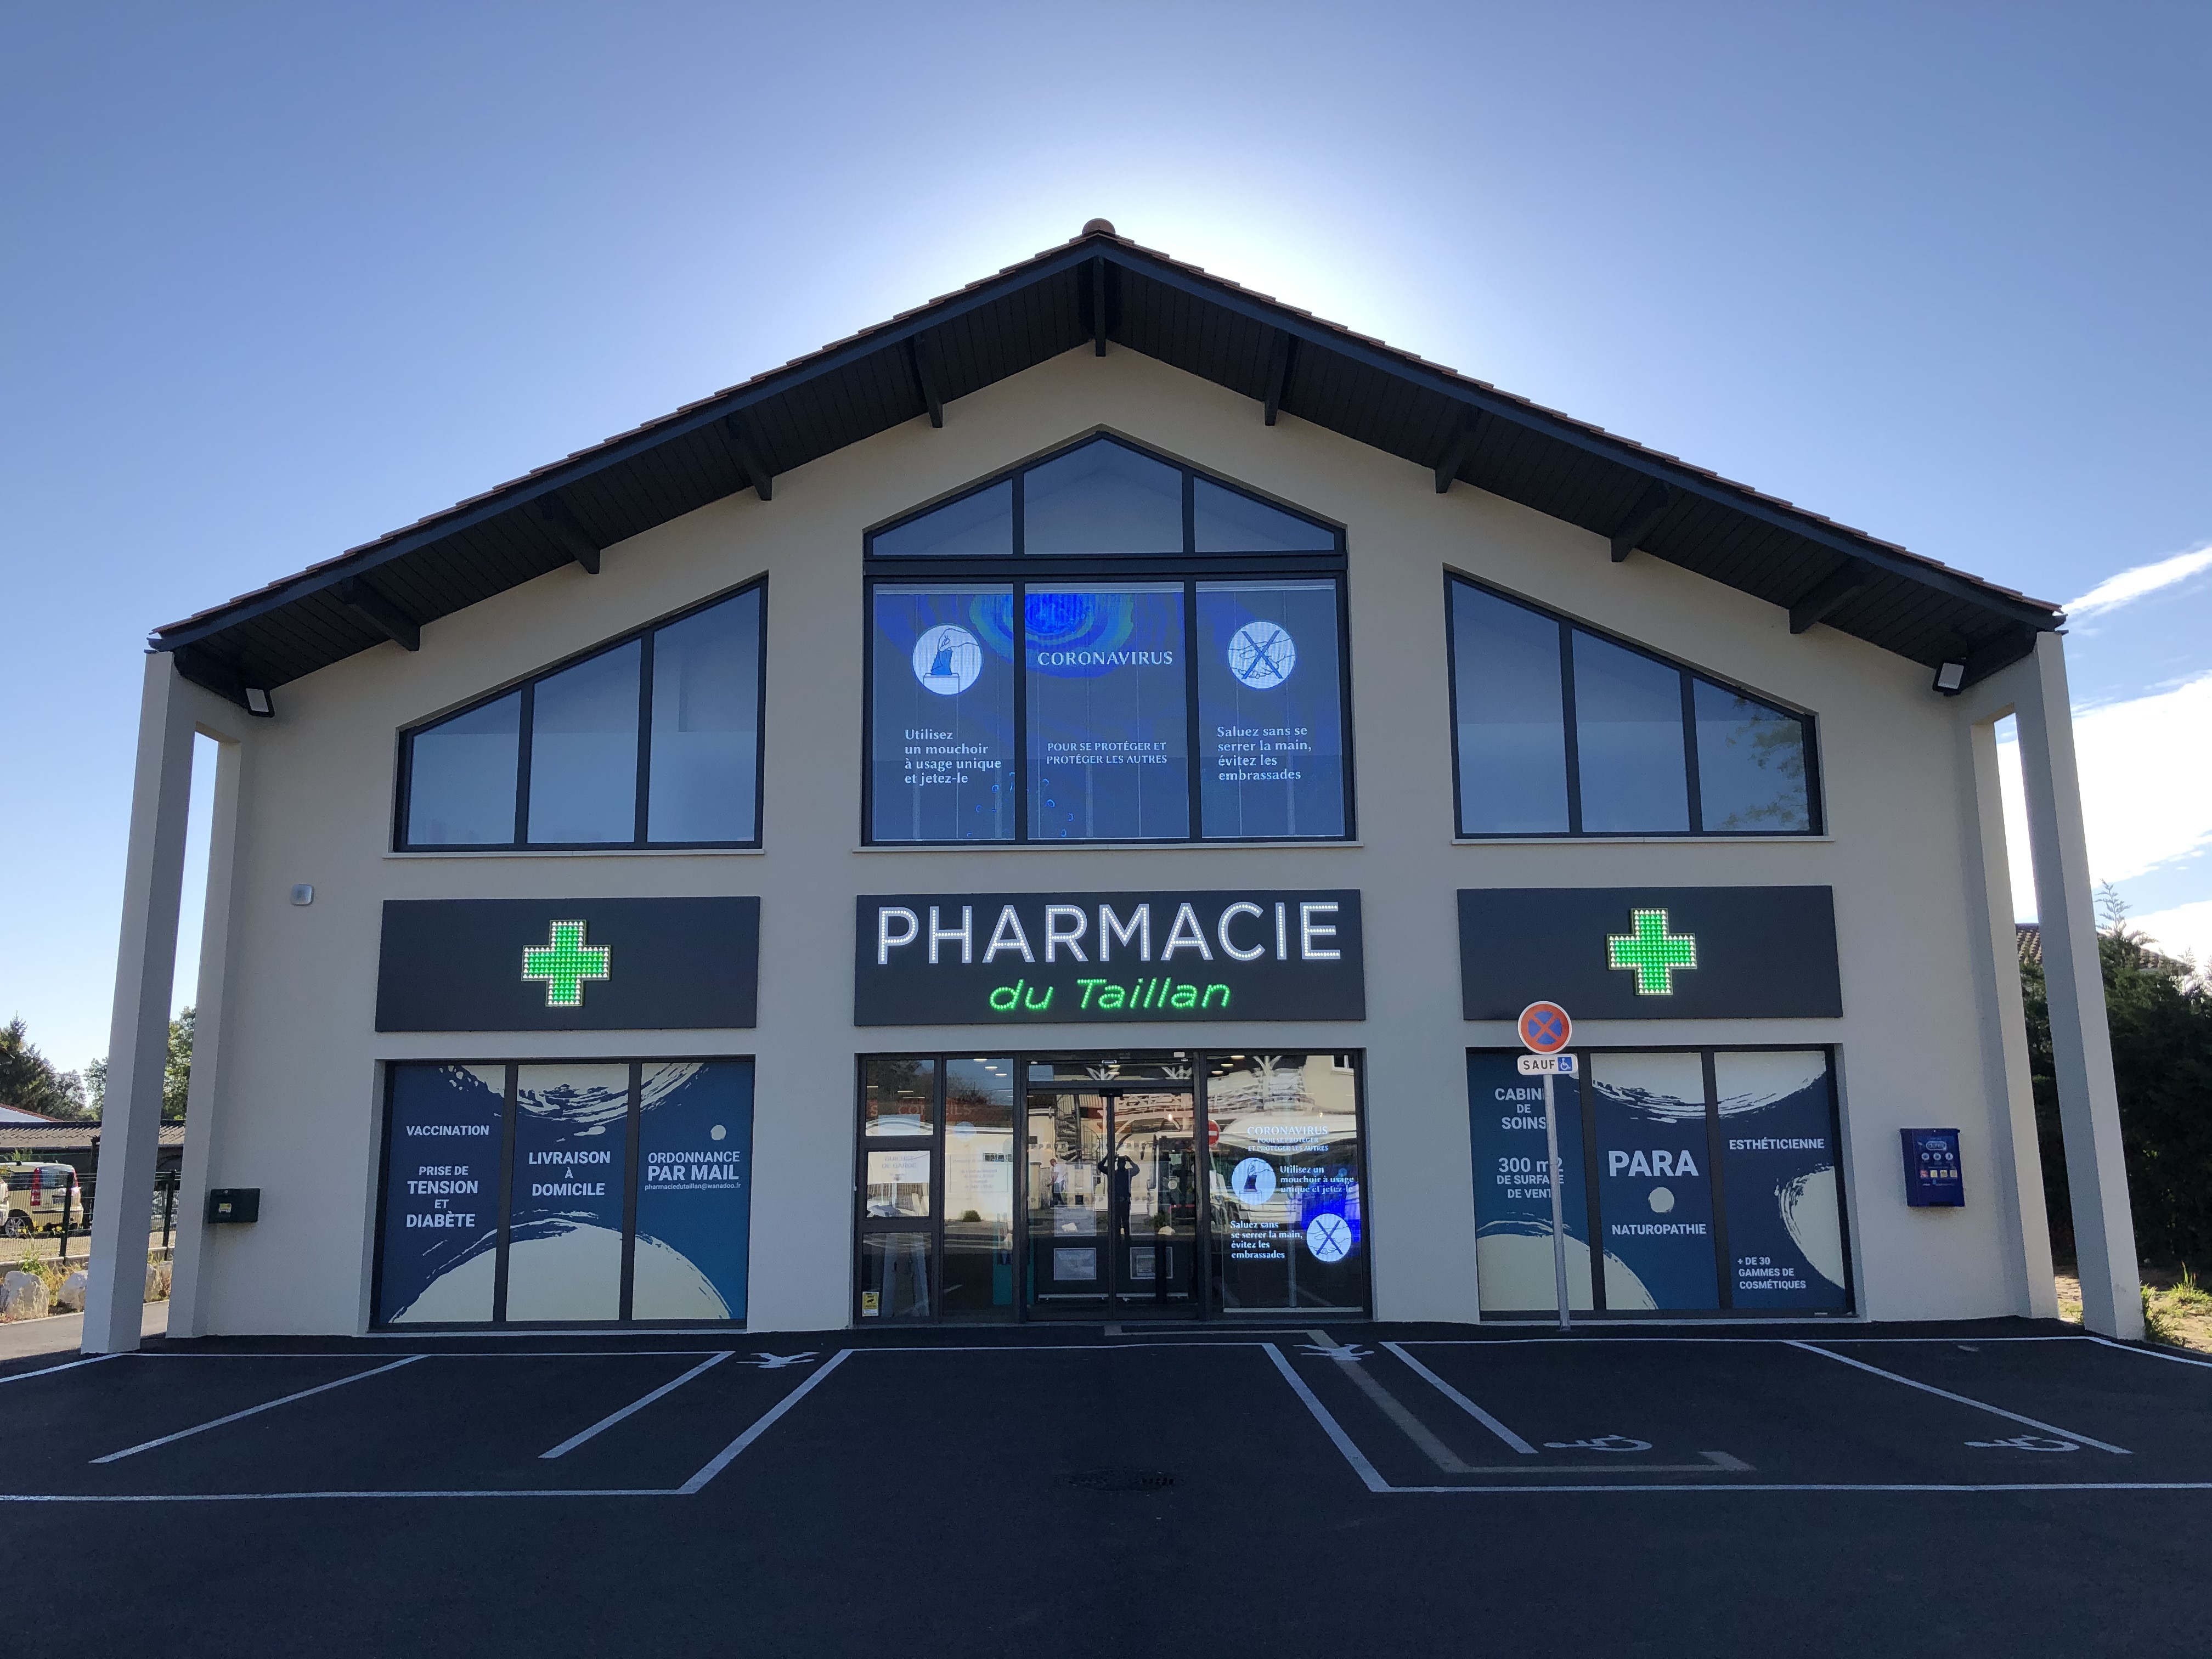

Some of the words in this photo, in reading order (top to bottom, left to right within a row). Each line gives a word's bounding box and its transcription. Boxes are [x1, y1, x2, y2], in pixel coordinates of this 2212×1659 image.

[1037, 650, 1173, 666] CORONAVIRUS
[905, 728, 953, 740] Utilisez
[1217, 725, 1259, 737] Saluez
[1262, 727, 1290, 736] sans
[1294, 727, 1308, 736] se
[926, 743, 989, 754] mouchoir
[1048, 742, 1077, 752] POUR
[1080, 742, 1092, 751] SE
[1094, 741, 1151, 751] PROTÉGER
[1154, 742, 1167, 751] ET
[1217, 743, 1256, 751] serrer
[1260, 740, 1271, 751] la
[1275, 739, 1312, 752] main,
[905, 758, 912, 769] à
[916, 760, 952, 772] usage
[956, 757, 1002, 772] unique
[1047, 754, 1103, 764] PROTÉGER
[1106, 755, 1124, 764] LES
[1126, 754, 1167, 764] AUTRES
[1218, 754, 1256, 766] évitez
[1260, 754, 1278, 766] les
[905, 774, 917, 783] et
[919, 772, 968, 786] jetez-le
[1218, 768, 1301, 781] embrassades
[878, 902, 1341, 964] PHARMACIE
[988, 978, 1054, 1011] du
[1076, 977, 1231, 1009] Taillan
[1523, 1059, 1555, 1070] SAUF
[1494, 1088, 1544, 1101] CABIN
[1516, 1104, 1531, 1113] DE
[1502, 1116, 1546, 1129] SOINS
[406, 1125, 490, 1136] VACCINATION
[1247, 1126, 1328, 1135] CORONAVIRUS
[1729, 1137, 1825, 1150] ESTHÉTICIENNE
[529, 1151, 611, 1165] LIVRAISON
[648, 1151, 741, 1164] ORDONNANCE
[1609, 1150, 1700, 1177] PARA
[419, 1166, 452, 1176] PRISE
[454, 1166, 469, 1176] DE
[1280, 1165, 1311, 1173] Utilisez
[1498, 1158, 1531, 1172] 300
[565, 1166, 574, 1178] À
[648, 1165, 686, 1181] PAR
[691, 1164, 739, 1180] MAIL
[1497, 1175, 1511, 1184] DE
[1514, 1175, 1565, 1184] SURFAE
[407, 1180, 478, 1194] TENSION
[532, 1183, 606, 1197] DOMICILE
[645, 1182, 741, 1191] pharmaciedutaillan@wanadoo.fr
[1280, 1186, 1310, 1194] unique
[1322, 1185, 1353, 1194] jetez-le
[1508, 1189, 1522, 1198] DE
[1524, 1188, 1551, 1198] VENT
[435, 1199, 449, 1209] ET
[406, 1211, 476, 1228] DIABÈTE
[1231, 1220, 1258, 1228] Saluez
[1269, 1230, 1277, 1238] la
[1279, 1231, 1303, 1239] main,
[1612, 1224, 1707, 1235] NATUROPATHIE
[1231, 1250, 1285, 1259] embrassades
[1782, 1268, 1795, 1276] DE
[1739, 1279, 1806, 1290] COSMÉTIQUES
